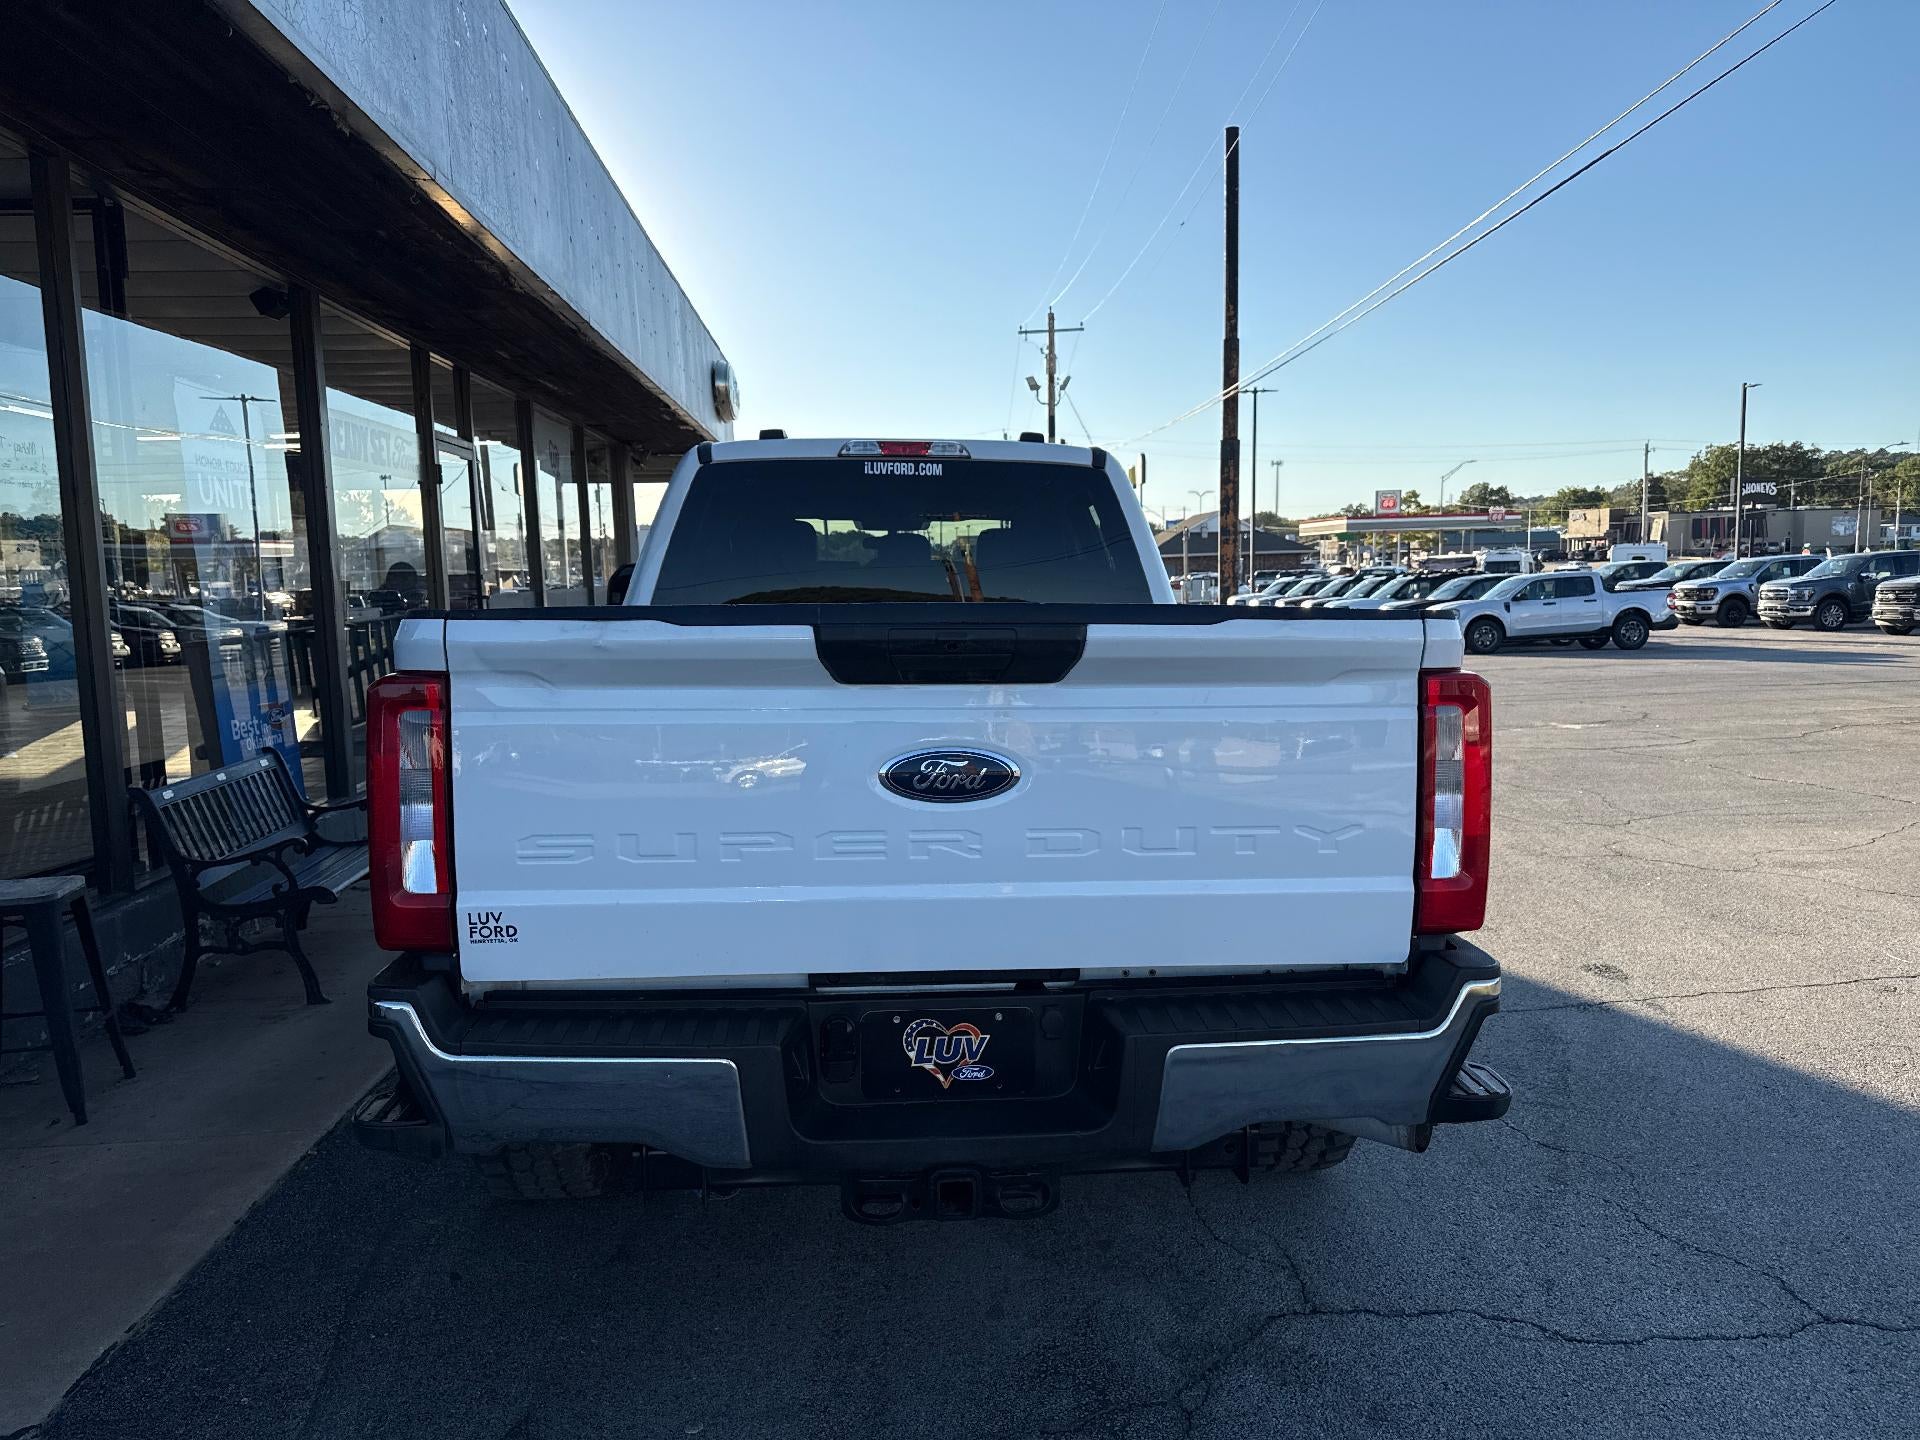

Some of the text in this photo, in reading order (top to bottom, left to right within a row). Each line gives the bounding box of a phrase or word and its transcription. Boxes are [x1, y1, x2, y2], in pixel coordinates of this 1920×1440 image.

[864, 461, 943, 476] iLUVFORD.COM
[231, 715, 260, 741] Best
[912, 759, 988, 791] Ford
[516, 823, 1365, 865] SUPER DUTY
[468, 912, 502, 925] LUV
[469, 925, 518, 939] FORD
[911, 1034, 991, 1068] LUV
[959, 1067, 986, 1079] Ford
